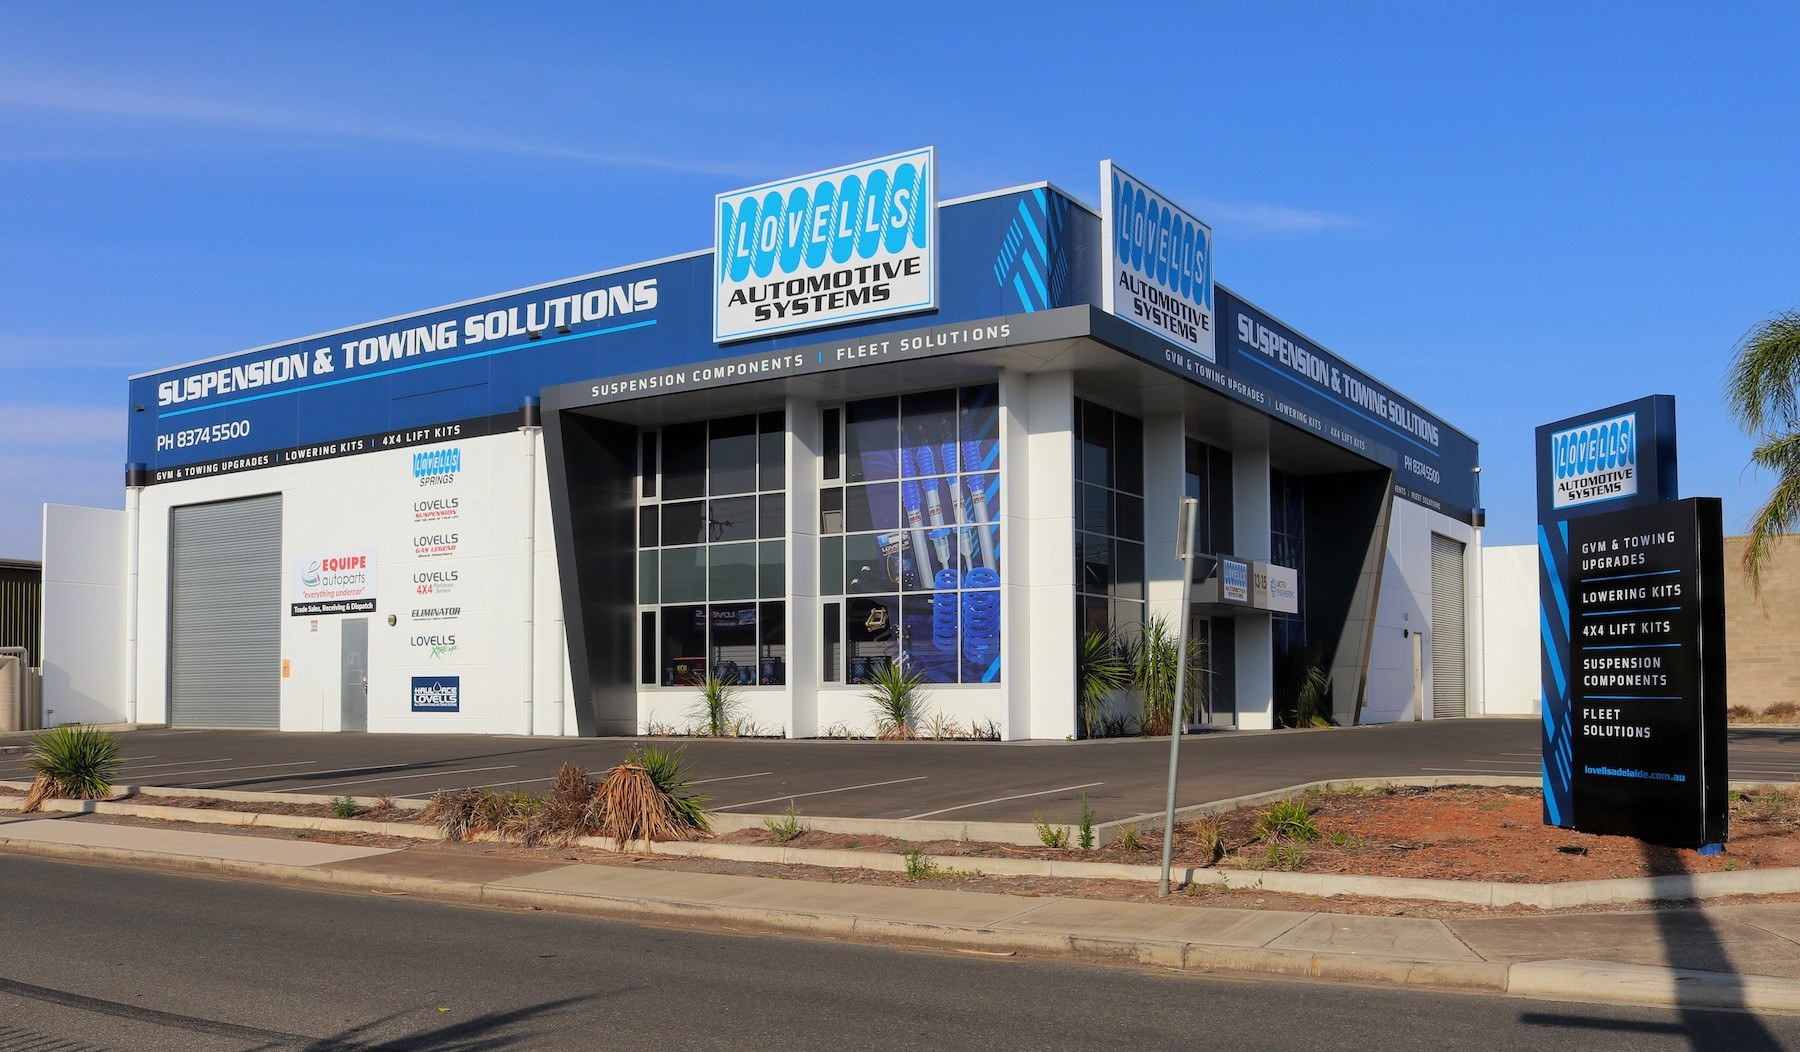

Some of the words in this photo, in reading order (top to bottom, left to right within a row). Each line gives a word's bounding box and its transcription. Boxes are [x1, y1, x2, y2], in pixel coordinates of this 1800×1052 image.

[736, 188, 910, 258] LOVELLS
[1122, 203, 1204, 285] LOVELLS
[728, 256, 921, 308] AUTOMOTIVE
[754, 282, 890, 322] SYSTEMS
[1119, 270, 1209, 332] AUTOMOTIVE
[1133, 297, 1198, 344] SYSTEMS
[158, 352, 308, 407] SUSPENSION
[313, 346, 335, 375] &
[341, 319, 458, 370] TOWING
[464, 277, 659, 345] SOLUTIONS
[836, 341, 890, 361] FLEET
[900, 324, 1011, 351] SOLUTIONS
[591, 372, 686, 398] SUSPENSION
[692, 354, 804, 382] COMPONENTS
[1165, 349, 1184, 367] GVM
[1186, 358, 1193, 371] &
[1194, 363, 1226, 386] TOWING
[1227, 378, 1265, 404] UPGRADES
[1237, 312, 1330, 388] SUSPENSION
[1331, 367, 1342, 395] &
[1342, 372, 1387, 419] TOWING
[1388, 399, 1439, 447] SOLUTIONS
[1275, 400, 1307, 425] LOWERING
[1308, 416, 1322, 431] KITS
[157, 433, 174, 452] PH
[382, 435, 402, 446] 4X4
[406, 429, 430, 442] LIFT
[435, 424, 461, 438] KITS
[1330, 426, 1340, 441] 4X4
[1341, 431, 1353, 445] LIFT
[1354, 436, 1366, 450] KITS
[285, 444, 337, 461] LOWERING
[340, 440, 364, 452] KITS
[1560, 432, 1629, 467] LOVELLS
[157, 470, 174, 481] GVM
[176, 469, 182, 478] &
[185, 463, 218, 477] TOWING
[222, 455, 269, 471] UPGRADES
[416, 454, 458, 471] LOVELLS
[1404, 455, 1413, 472] PH
[419, 473, 454, 487] SPRINGS
[1557, 468, 1633, 493] AUTOMOTIVE
[1568, 482, 1622, 501] SYSTEMS
[413, 497, 459, 512] LOVELLS
[413, 533, 459, 547] LOVELLS
[1582, 540, 1606, 554] GVM
[1611, 539, 1619, 550] &
[1623, 531, 1675, 549] TOWING
[322, 555, 367, 572] EQUIPE
[1582, 553, 1646, 571] UPGRADES
[321, 572, 366, 588] autoparts
[413, 570, 459, 584] LOVELLS
[416, 583, 434, 595] 4X4
[1582, 587, 1646, 604] LOWERING
[1651, 584, 1682, 598] KITS
[293, 605, 308, 613] Trade
[322, 603, 346, 612] Receiving
[351, 602, 373, 611] Dispatch
[411, 607, 461, 618] ELIMINATOR
[1583, 625, 1604, 637] 4X4
[1609, 622, 1636, 636] LIFT
[1641, 620, 1671, 634] KITS
[410, 635, 456, 647] LOVELLS
[1583, 656, 1661, 670] SUSPENSION
[1583, 674, 1668, 687] COMPONENTS
[413, 695, 457, 704] LOVELLS
[1583, 708, 1621, 721] FLEET
[1583, 724, 1651, 739] SOLUTIONS
[1584, 765, 1686, 783] lovellsadelaide.com.au
